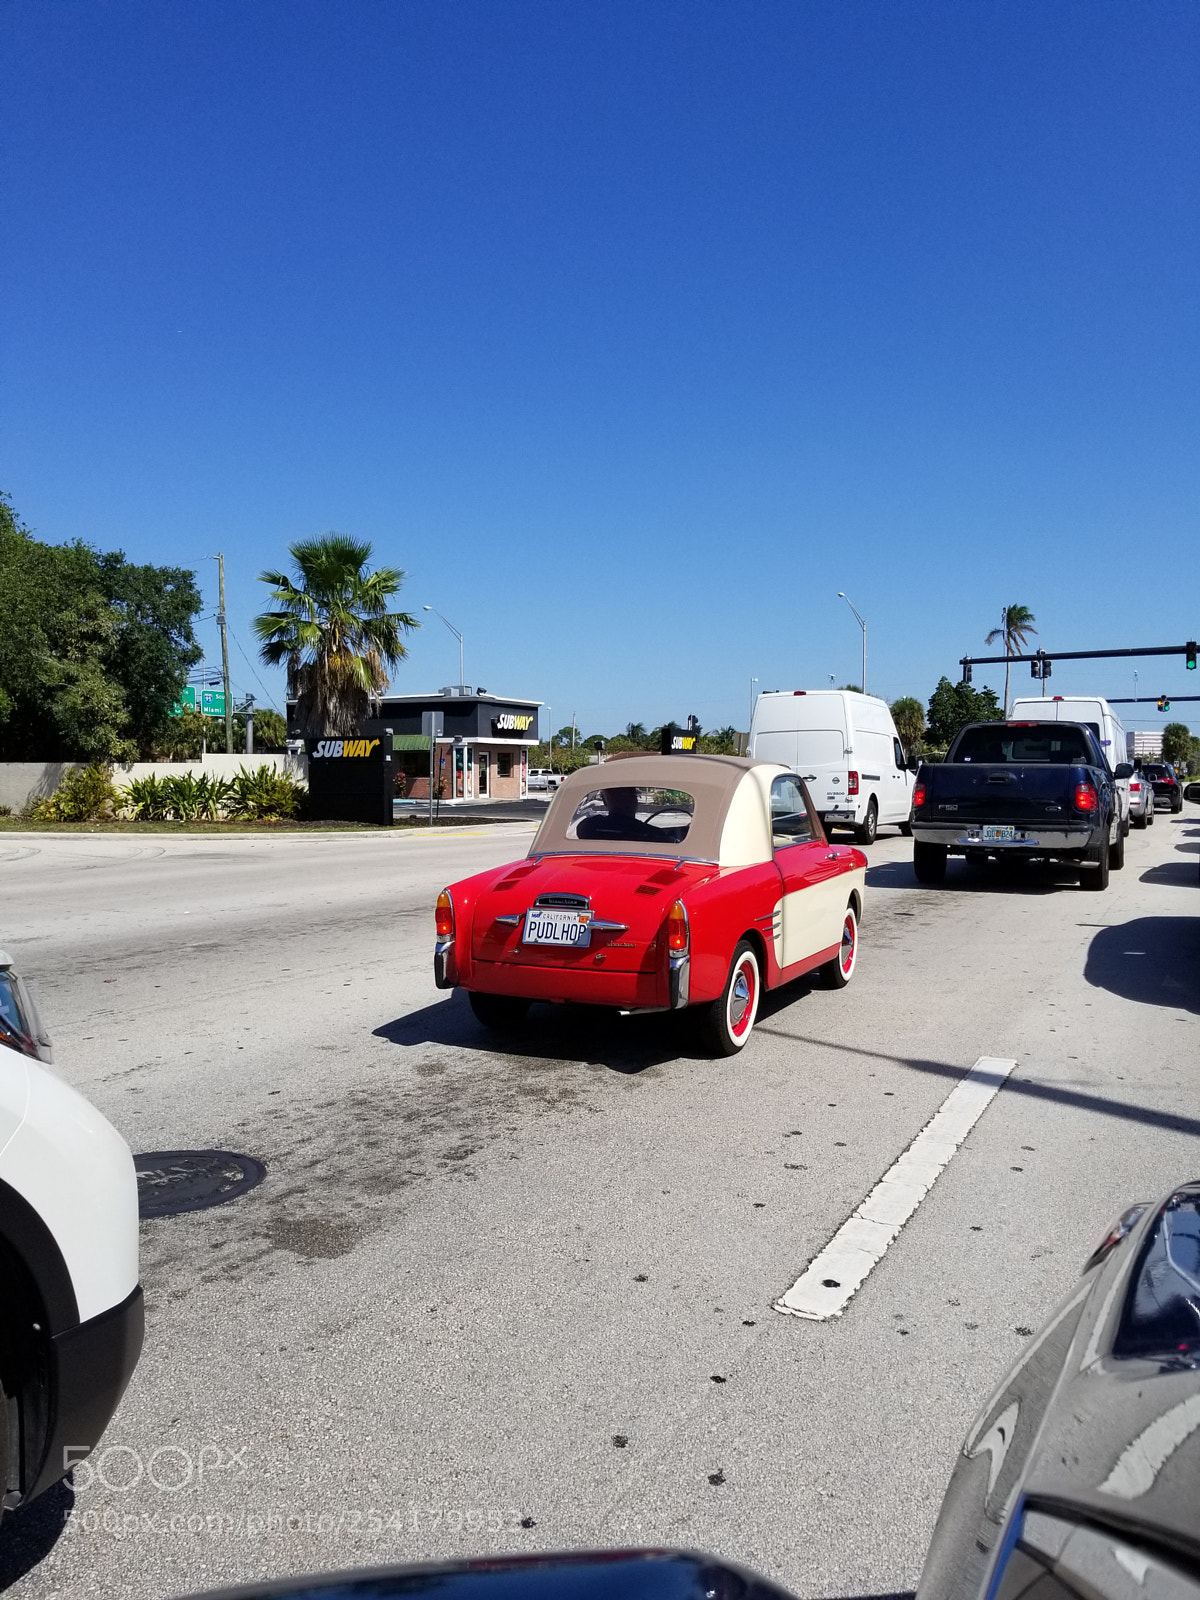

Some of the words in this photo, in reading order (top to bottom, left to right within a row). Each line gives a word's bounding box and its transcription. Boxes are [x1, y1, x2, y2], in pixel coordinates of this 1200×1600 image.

[497, 713, 534, 731] SUBWAY
[312, 738, 380, 758] SUBWAY
[671, 736, 696, 750] SUBWAY
[542, 913, 577, 921] CALIFORNIA
[528, 921, 587, 941] PUDLHOP
